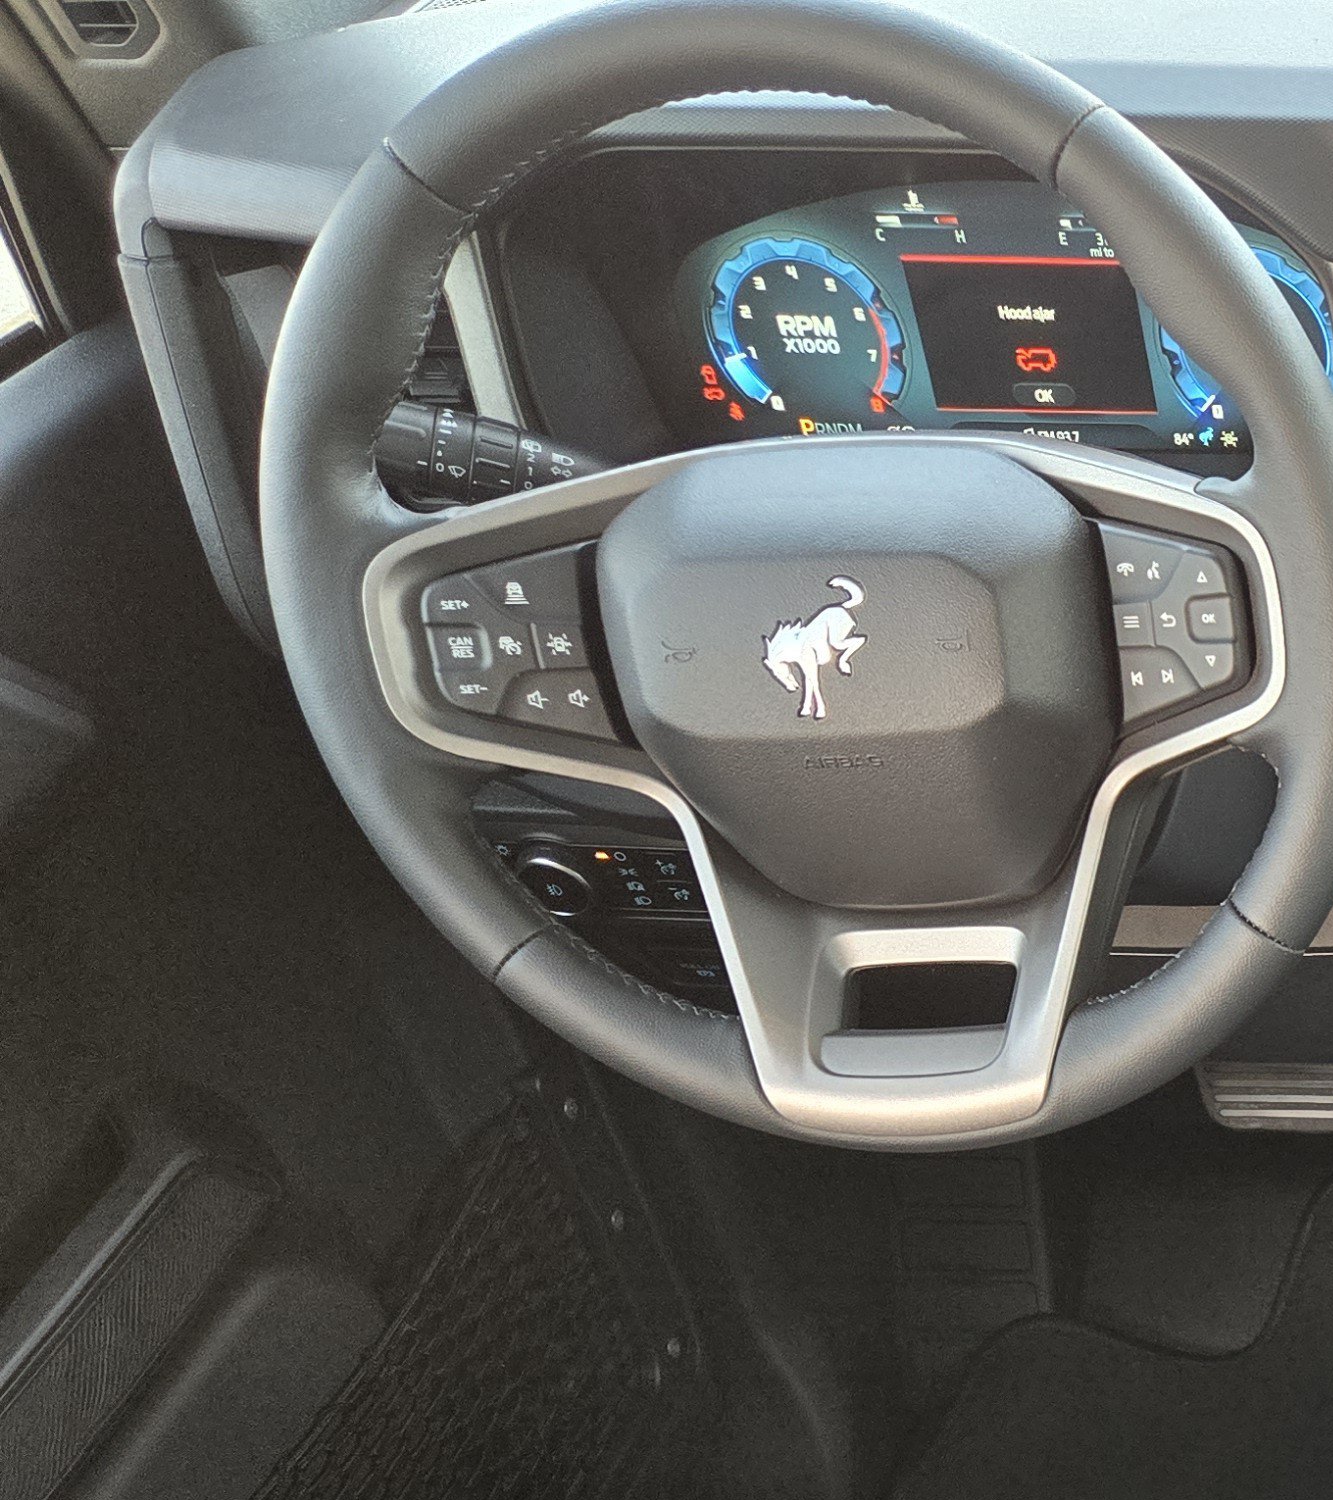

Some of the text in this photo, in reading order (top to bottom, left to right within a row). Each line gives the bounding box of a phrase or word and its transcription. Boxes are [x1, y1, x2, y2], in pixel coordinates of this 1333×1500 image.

[875, 228, 886, 241] C
[955, 229, 967, 244] H
[1058, 232, 1068, 246] E
[785, 265, 799, 280] 4
[752, 276, 767, 291] 3
[823, 277, 838, 293] 5
[737, 304, 753, 319] 2
[997, 305, 1056, 323] Hood ajar
[775, 314, 838, 337] RPM
[866, 349, 878, 362] 7
[770, 395, 786, 412] 0
[1034, 389, 1055, 403] OK
[869, 396, 886, 413] 8
[1201, 613, 1216, 624] OK
[447, 636, 475, 646] CAN
[451, 649, 476, 658] RES
